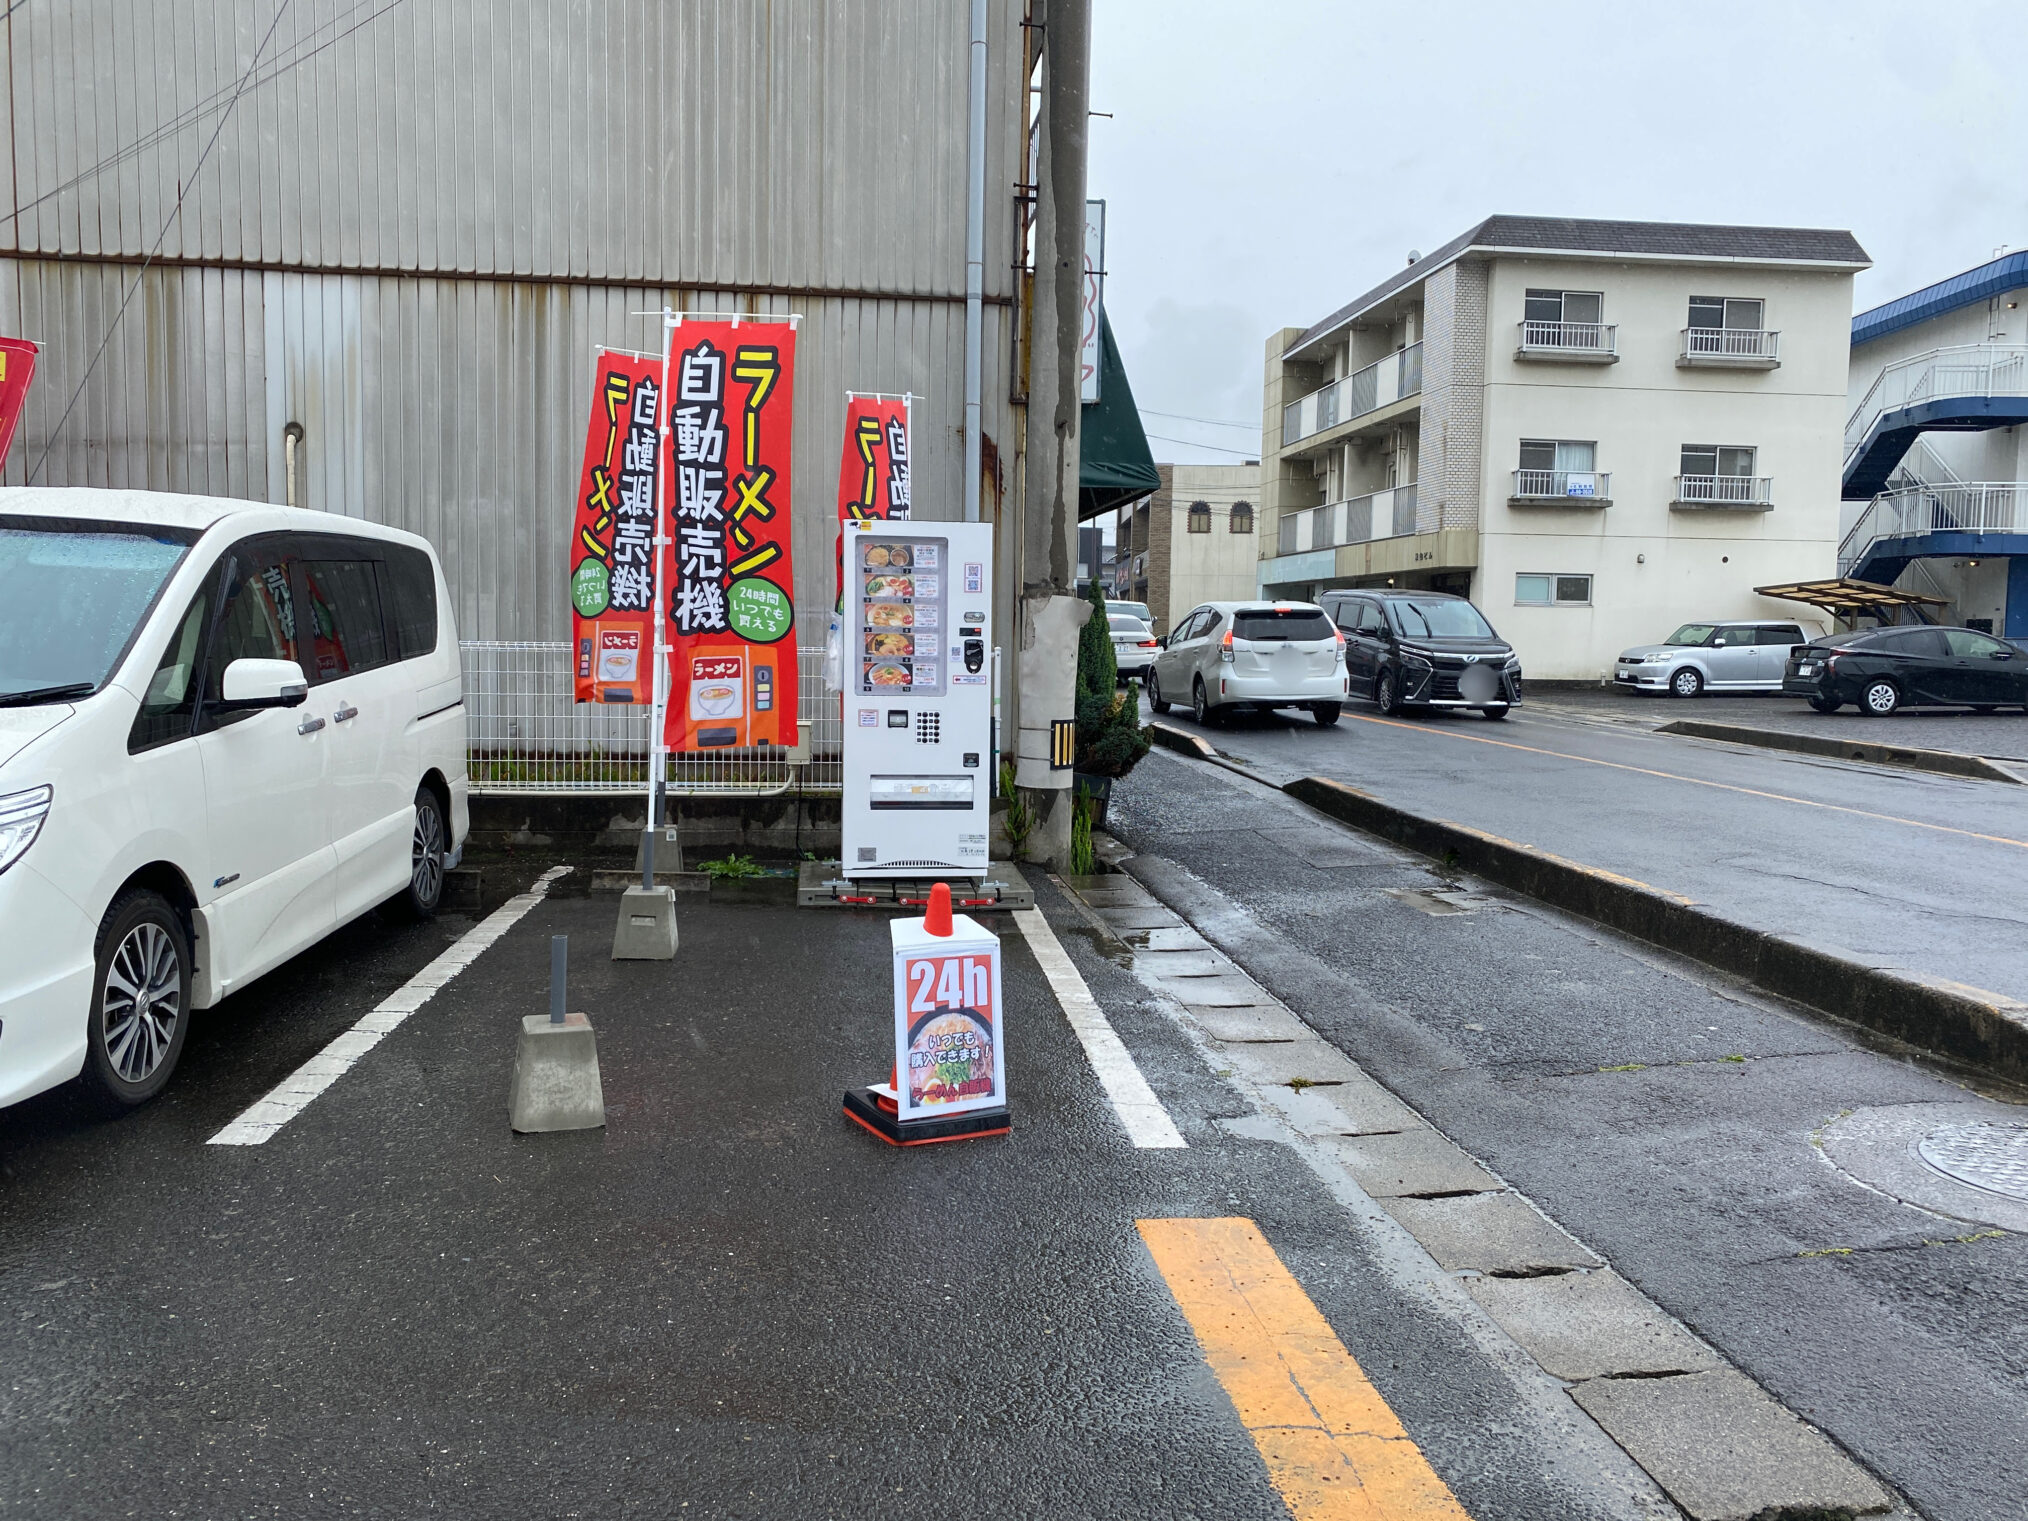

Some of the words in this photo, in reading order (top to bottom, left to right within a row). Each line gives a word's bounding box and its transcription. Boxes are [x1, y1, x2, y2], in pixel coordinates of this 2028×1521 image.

[731, 351, 778, 575] ラーメン
[674, 345, 727, 631] 自動販売機
[739, 586, 779, 606] 24時間
[733, 600, 784, 620] いつでも
[739, 614, 777, 632] 買える
[694, 662, 738, 676] ラーメン
[910, 957, 988, 1013] 24h
[928, 1031, 976, 1049] いつでも
[911, 1045, 990, 1069] 購入できます！
